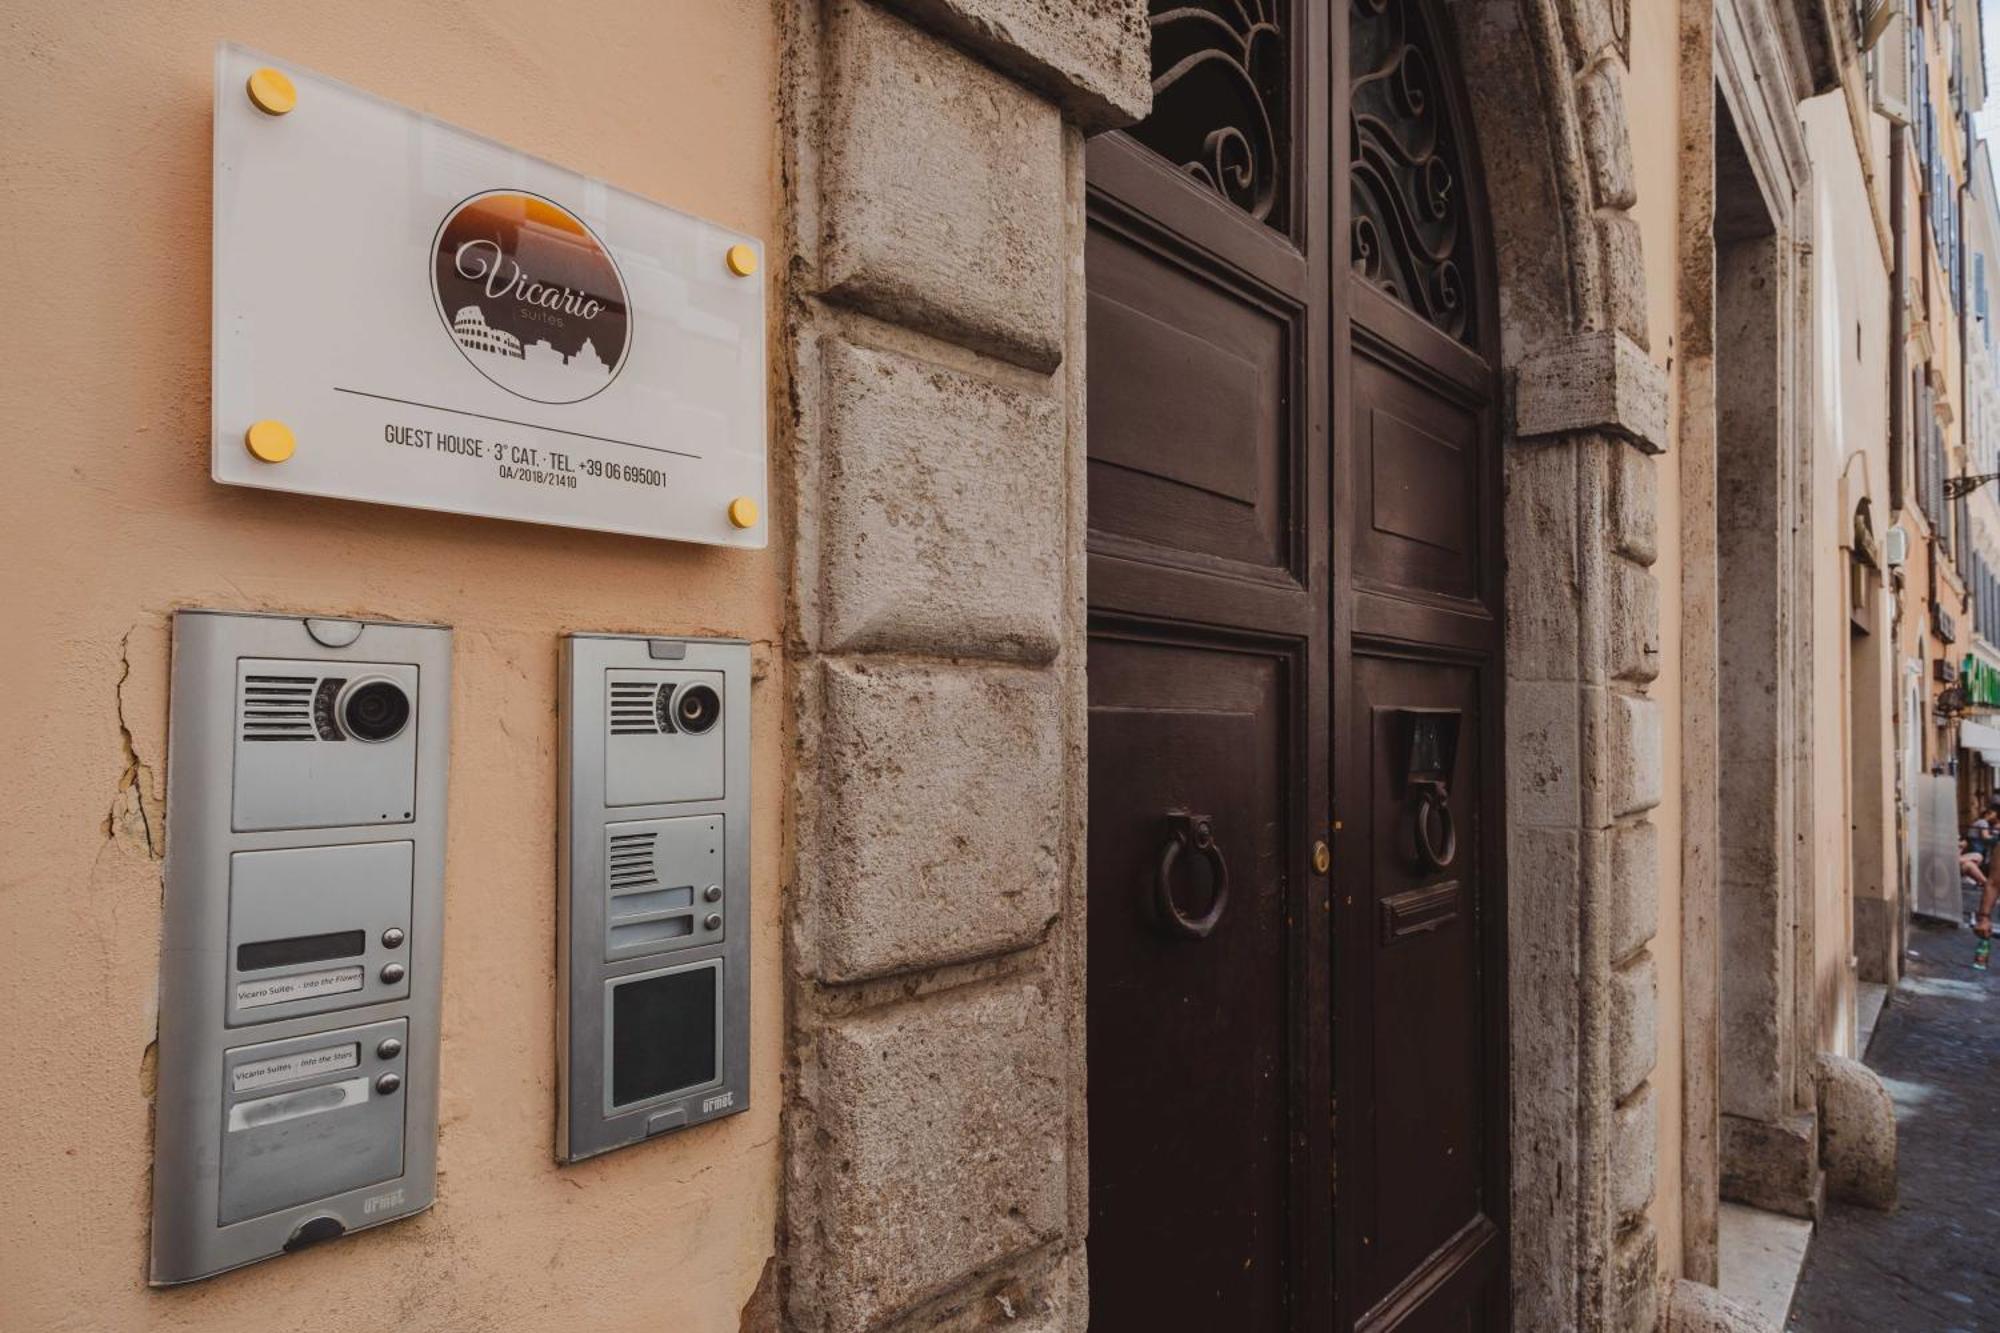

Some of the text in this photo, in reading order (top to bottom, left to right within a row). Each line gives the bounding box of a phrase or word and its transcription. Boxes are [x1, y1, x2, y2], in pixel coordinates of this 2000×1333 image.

[455, 239, 606, 320] Vicario
[384, 424, 433, 449] GUEST
[437, 433, 483, 458] HOUSE
[511, 446, 539, 467] CAT.
[549, 452, 576, 473] TEL.
[579, 459, 602, 477] +39
[605, 462, 621, 480] 06
[624, 465, 666, 488] 695001
[238, 990, 268, 1000] Vicario
[269, 984, 294, 995] Suites
[320, 976, 335, 986] the
[236, 1069, 265, 1080] Vicario
[267, 1063, 292, 1074] Suites
[318, 1055, 332, 1064] the
